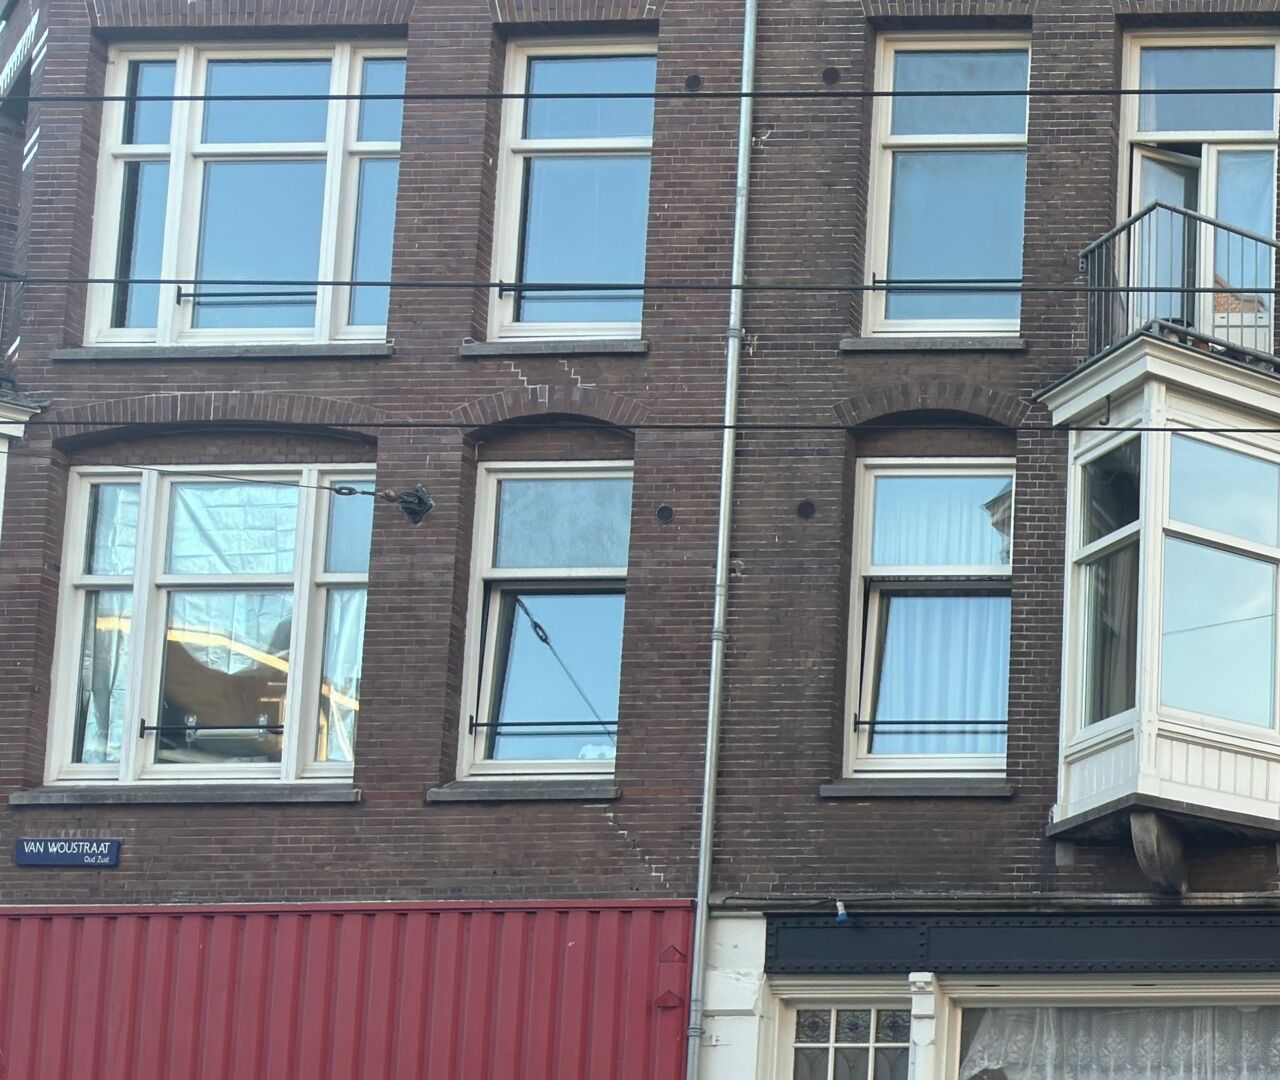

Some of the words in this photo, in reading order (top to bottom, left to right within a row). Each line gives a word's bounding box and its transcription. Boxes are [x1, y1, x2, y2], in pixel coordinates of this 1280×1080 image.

[24, 841, 44, 854] VAN
[48, 841, 110, 854] WOUSTRAAT
[84, 855, 95, 863] Oud
[97, 855, 109, 863] Zuid
